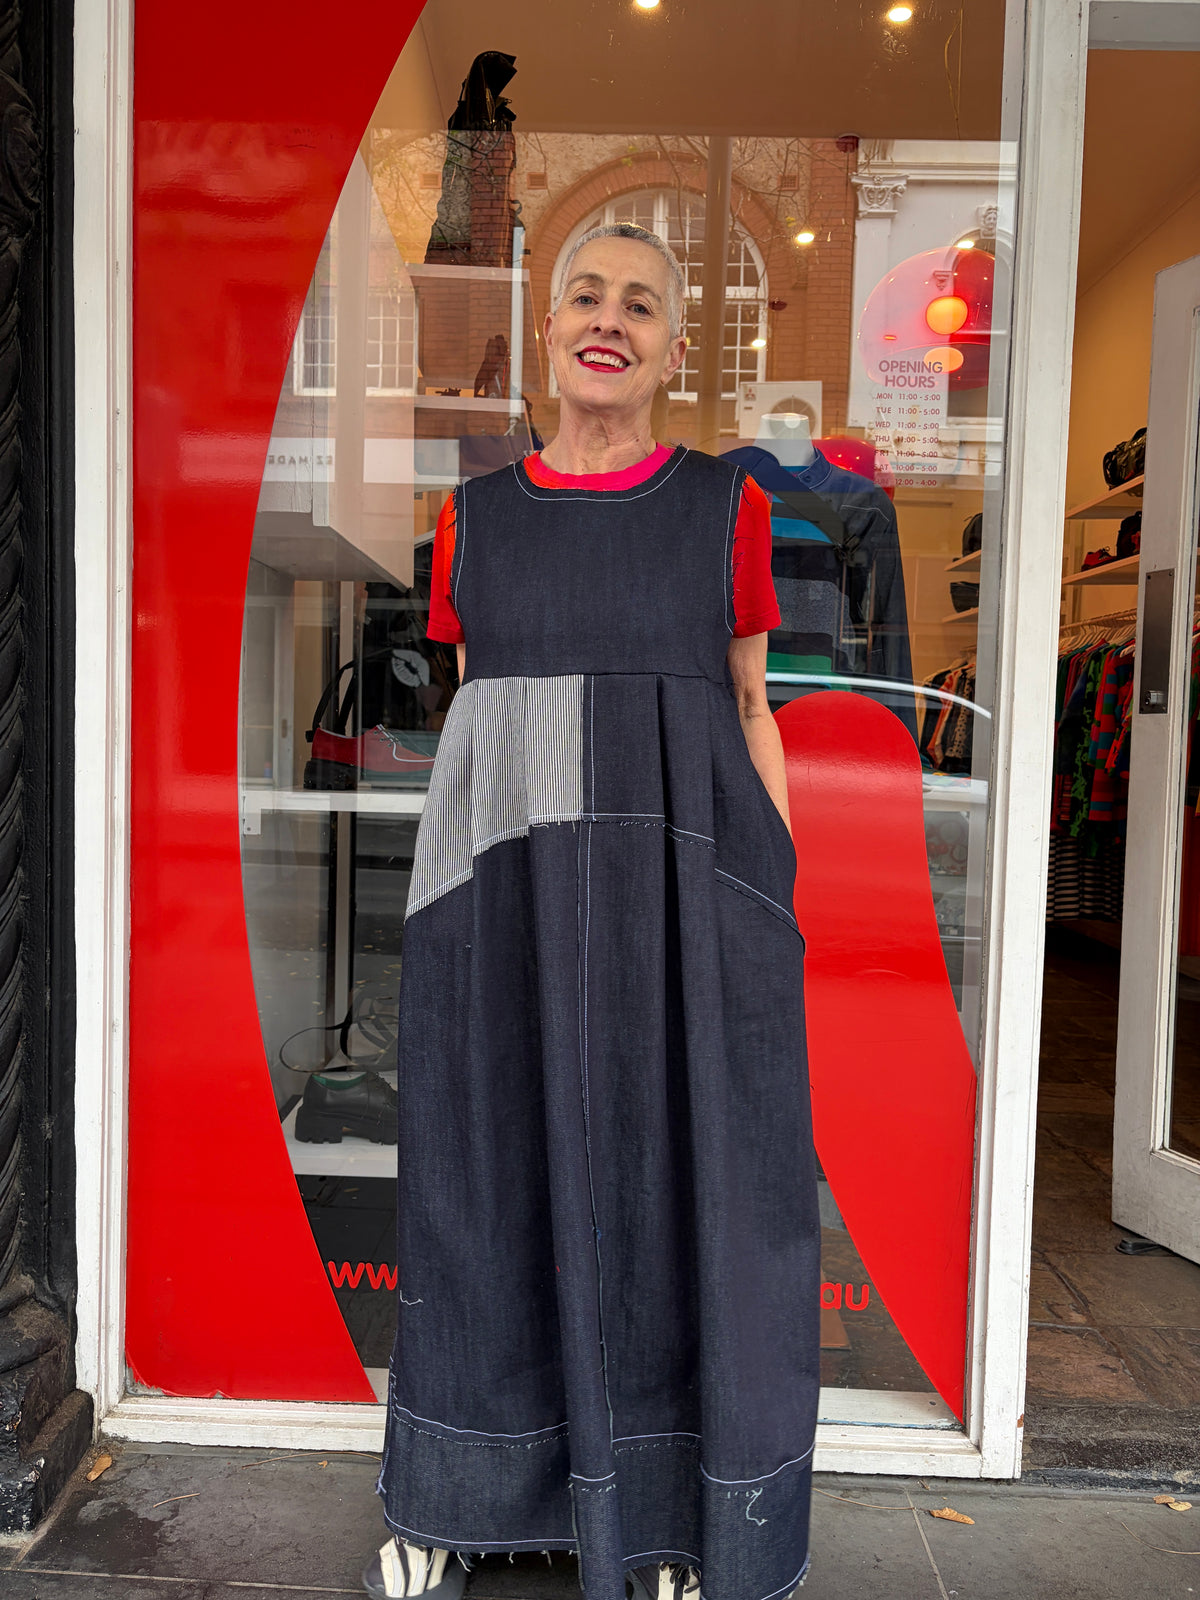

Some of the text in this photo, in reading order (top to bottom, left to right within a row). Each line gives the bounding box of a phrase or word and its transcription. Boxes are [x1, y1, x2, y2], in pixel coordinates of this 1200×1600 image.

[878, 360, 943, 374] OPENING
[884, 375, 935, 388] HOURS
[820, 1282, 869, 1311] au
